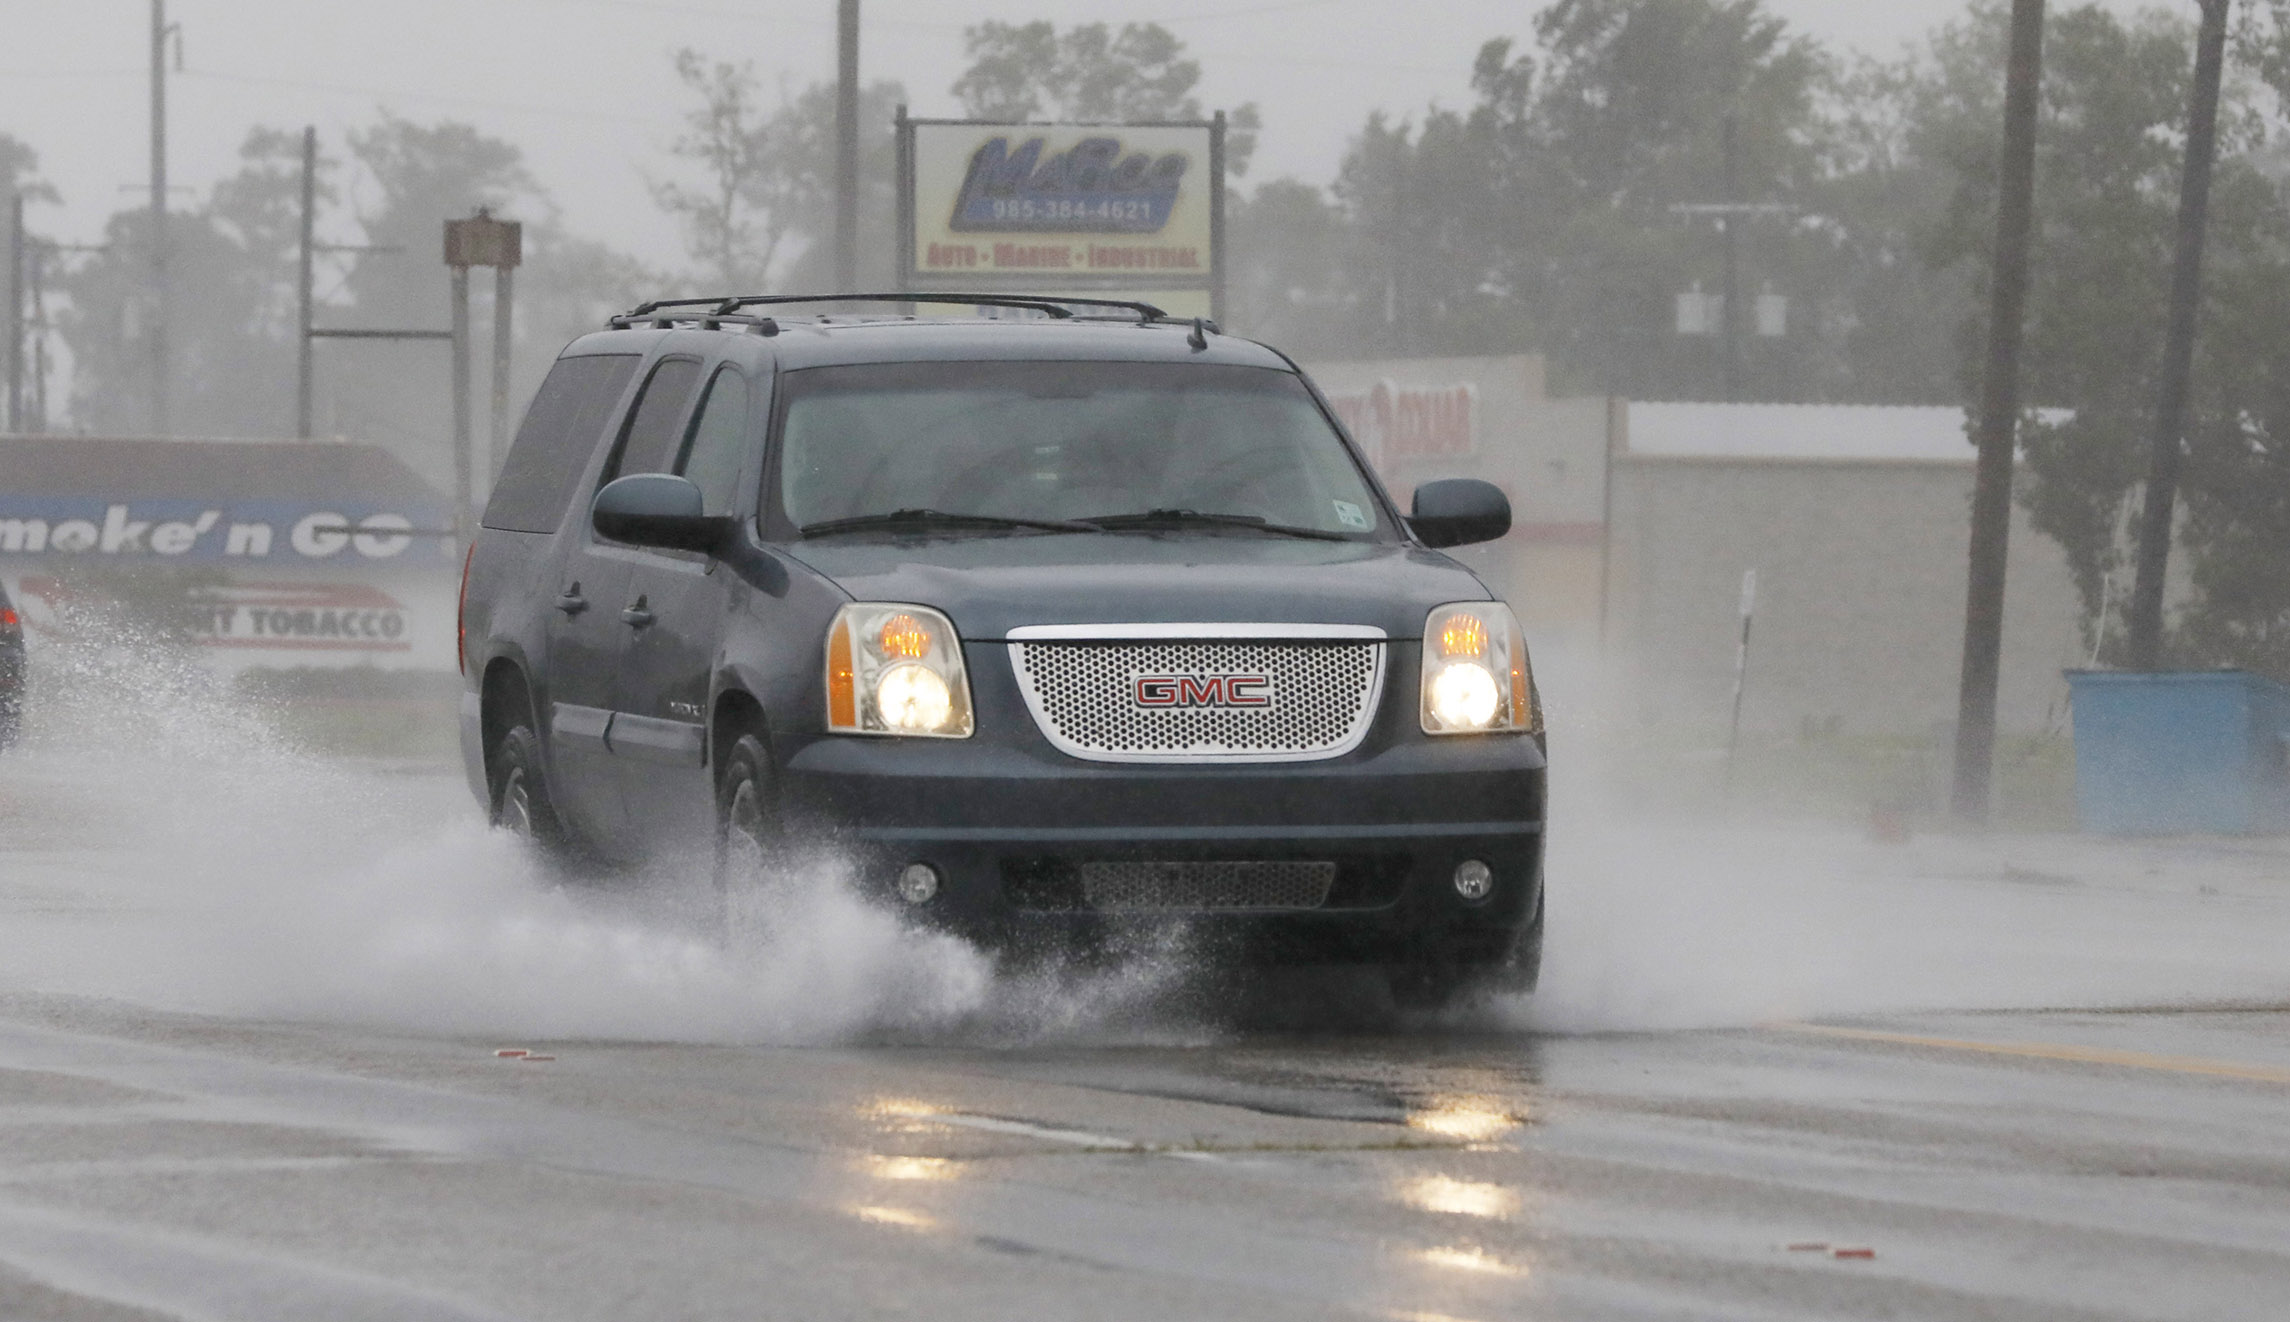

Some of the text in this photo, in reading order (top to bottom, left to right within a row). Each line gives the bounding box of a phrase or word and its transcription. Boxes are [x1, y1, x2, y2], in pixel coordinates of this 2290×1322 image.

[992, 200, 1151, 219] 985-384-4621
[928, 243, 1199, 268] AUTO MARINE INDUSTRIAL
[291, 512, 412, 557] GO
[250, 608, 404, 638] TOBACCO
[1134, 676, 1271, 707] GMC
